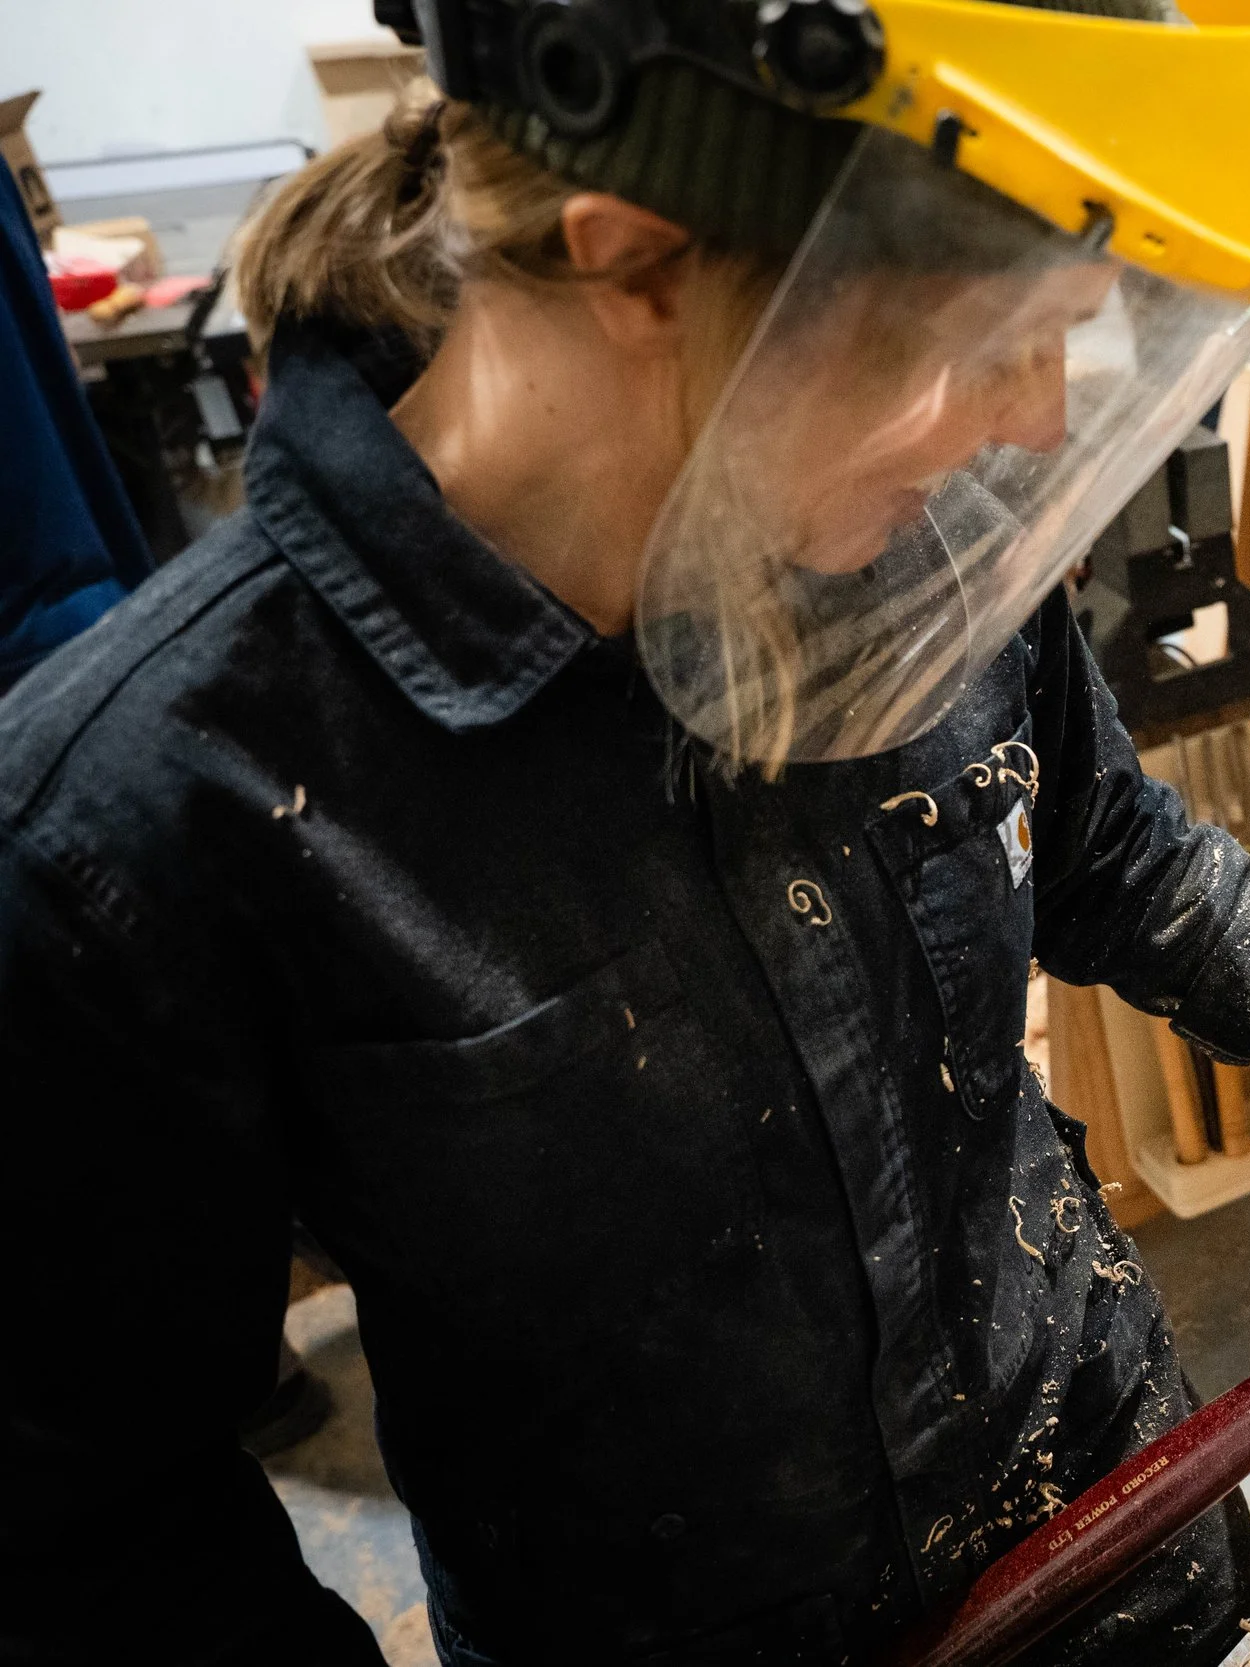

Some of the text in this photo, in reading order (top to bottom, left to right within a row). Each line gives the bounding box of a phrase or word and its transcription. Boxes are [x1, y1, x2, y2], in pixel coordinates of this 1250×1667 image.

[1048, 1456, 1169, 1550] RECORD POWER LTD
